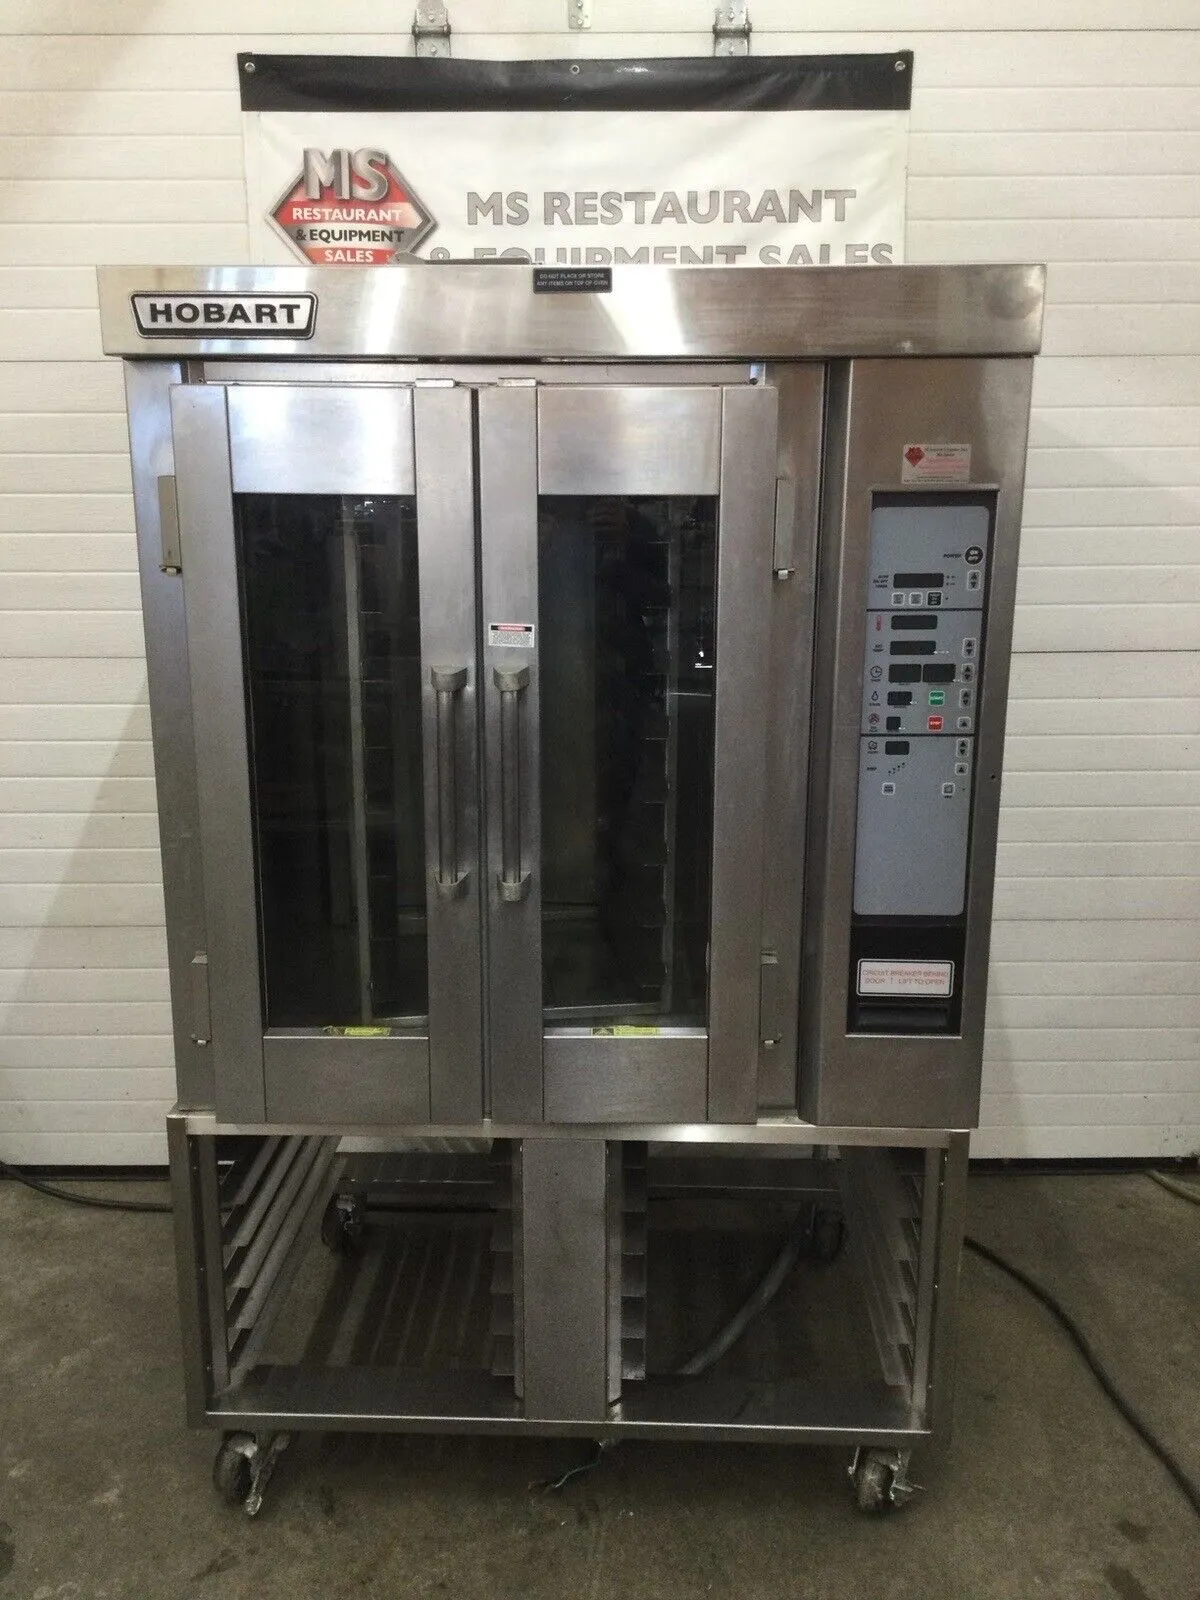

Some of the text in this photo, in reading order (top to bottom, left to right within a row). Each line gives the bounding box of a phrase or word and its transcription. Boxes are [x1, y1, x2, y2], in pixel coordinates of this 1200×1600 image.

[303, 147, 390, 202] MS
[292, 207, 403, 222] RESTAURANT
[467, 189, 857, 226] MS RESTAURANT
[296, 229, 405, 243] & EQUIPMENT
[324, 249, 374, 263] SALES
[150, 303, 301, 324] HOBART
